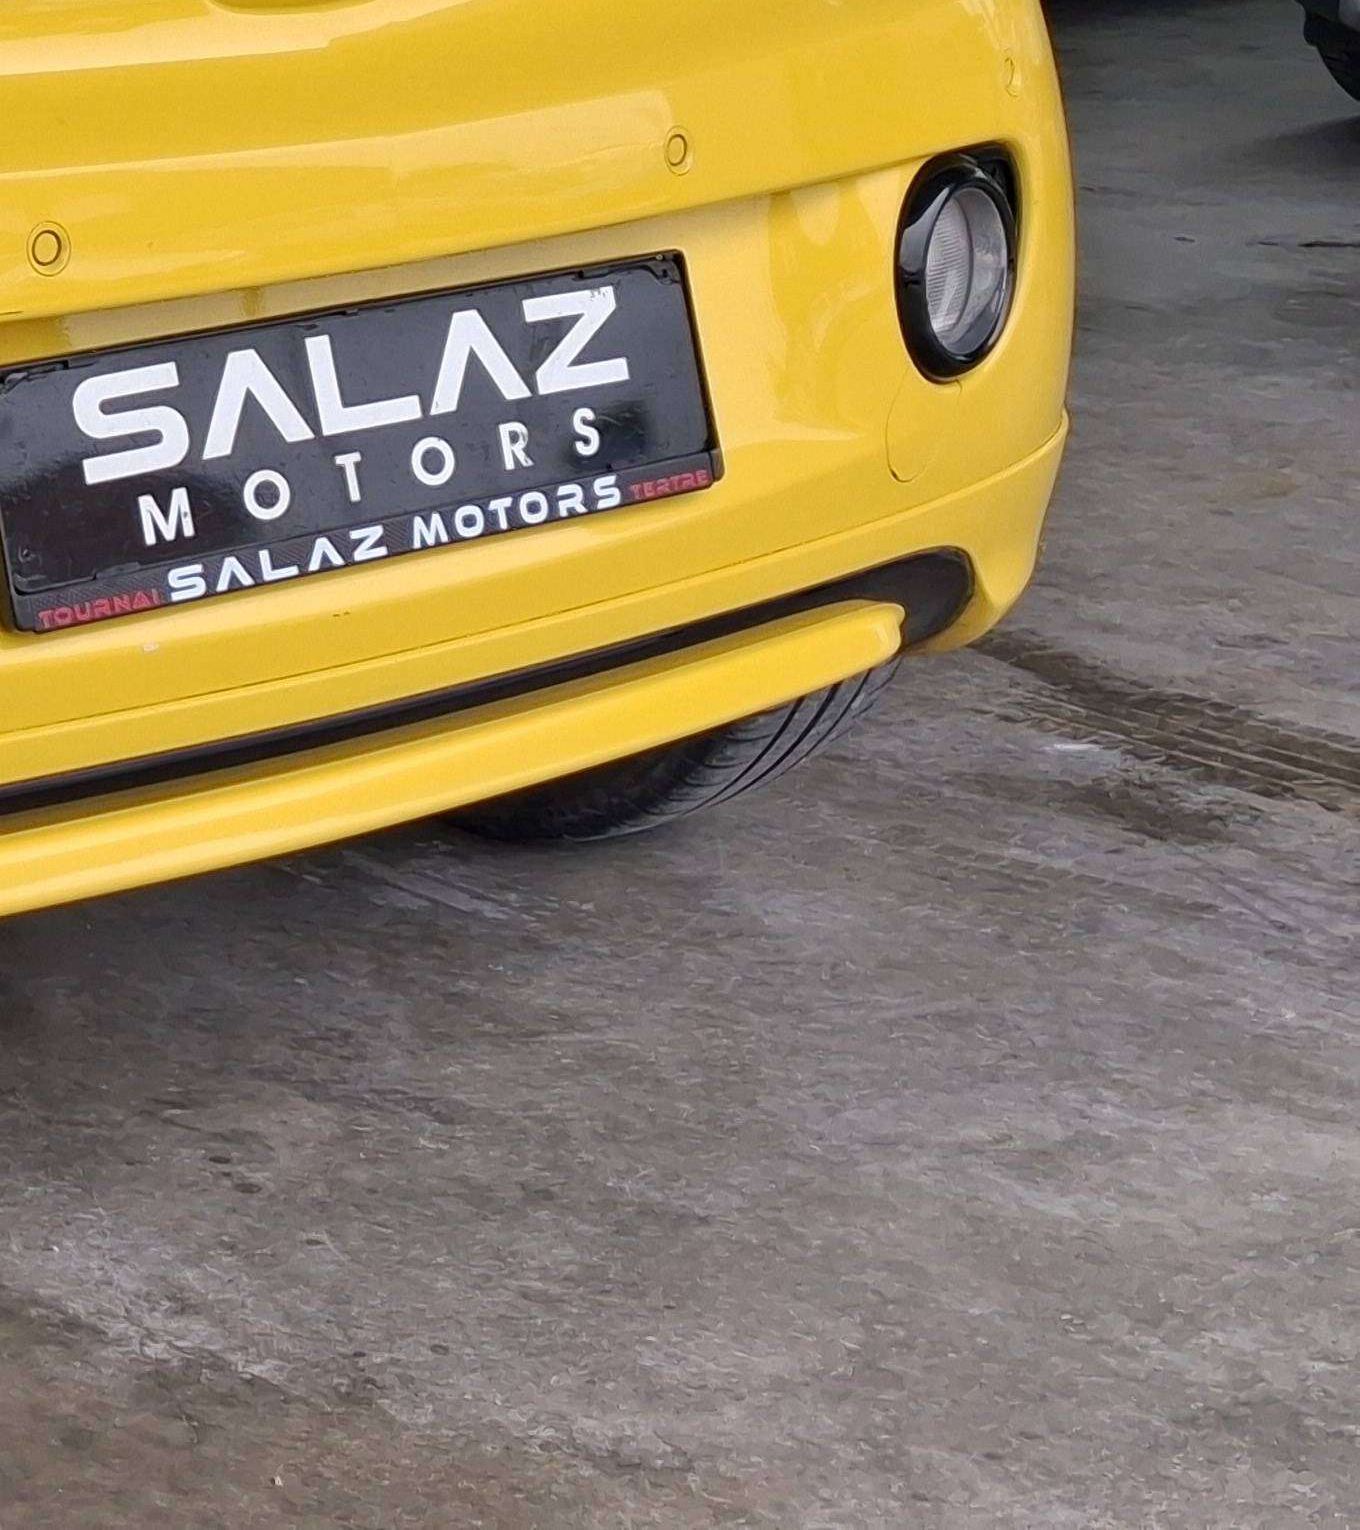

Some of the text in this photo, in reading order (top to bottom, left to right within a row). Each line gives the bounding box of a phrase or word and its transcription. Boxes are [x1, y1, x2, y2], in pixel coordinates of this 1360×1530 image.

[71, 284, 631, 486] SALAZ
[37, 469, 710, 629] TOURNAI SALAZ MOTORS TERTRE
[137, 407, 600, 546] MOTORS
